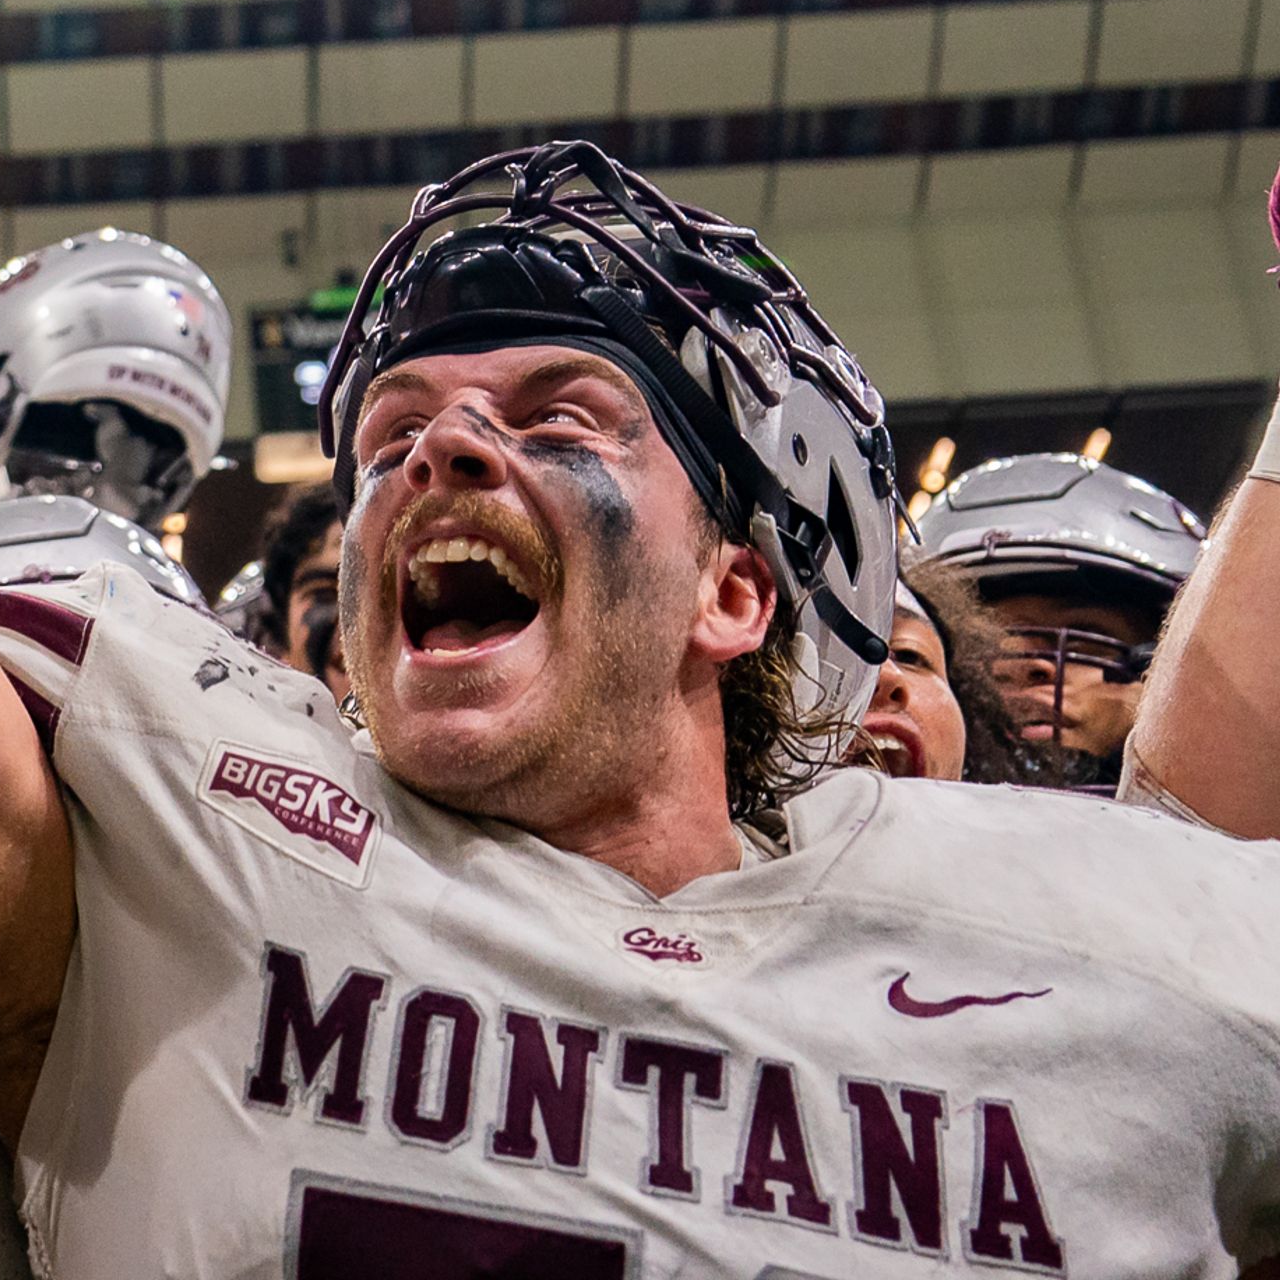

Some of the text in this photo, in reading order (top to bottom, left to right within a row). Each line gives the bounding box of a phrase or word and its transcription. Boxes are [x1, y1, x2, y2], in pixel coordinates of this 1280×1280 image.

[274, 806, 360, 848] CONFERENCE
[623, 927, 703, 962] Griz
[243, 940, 1068, 1280] MONTANA
